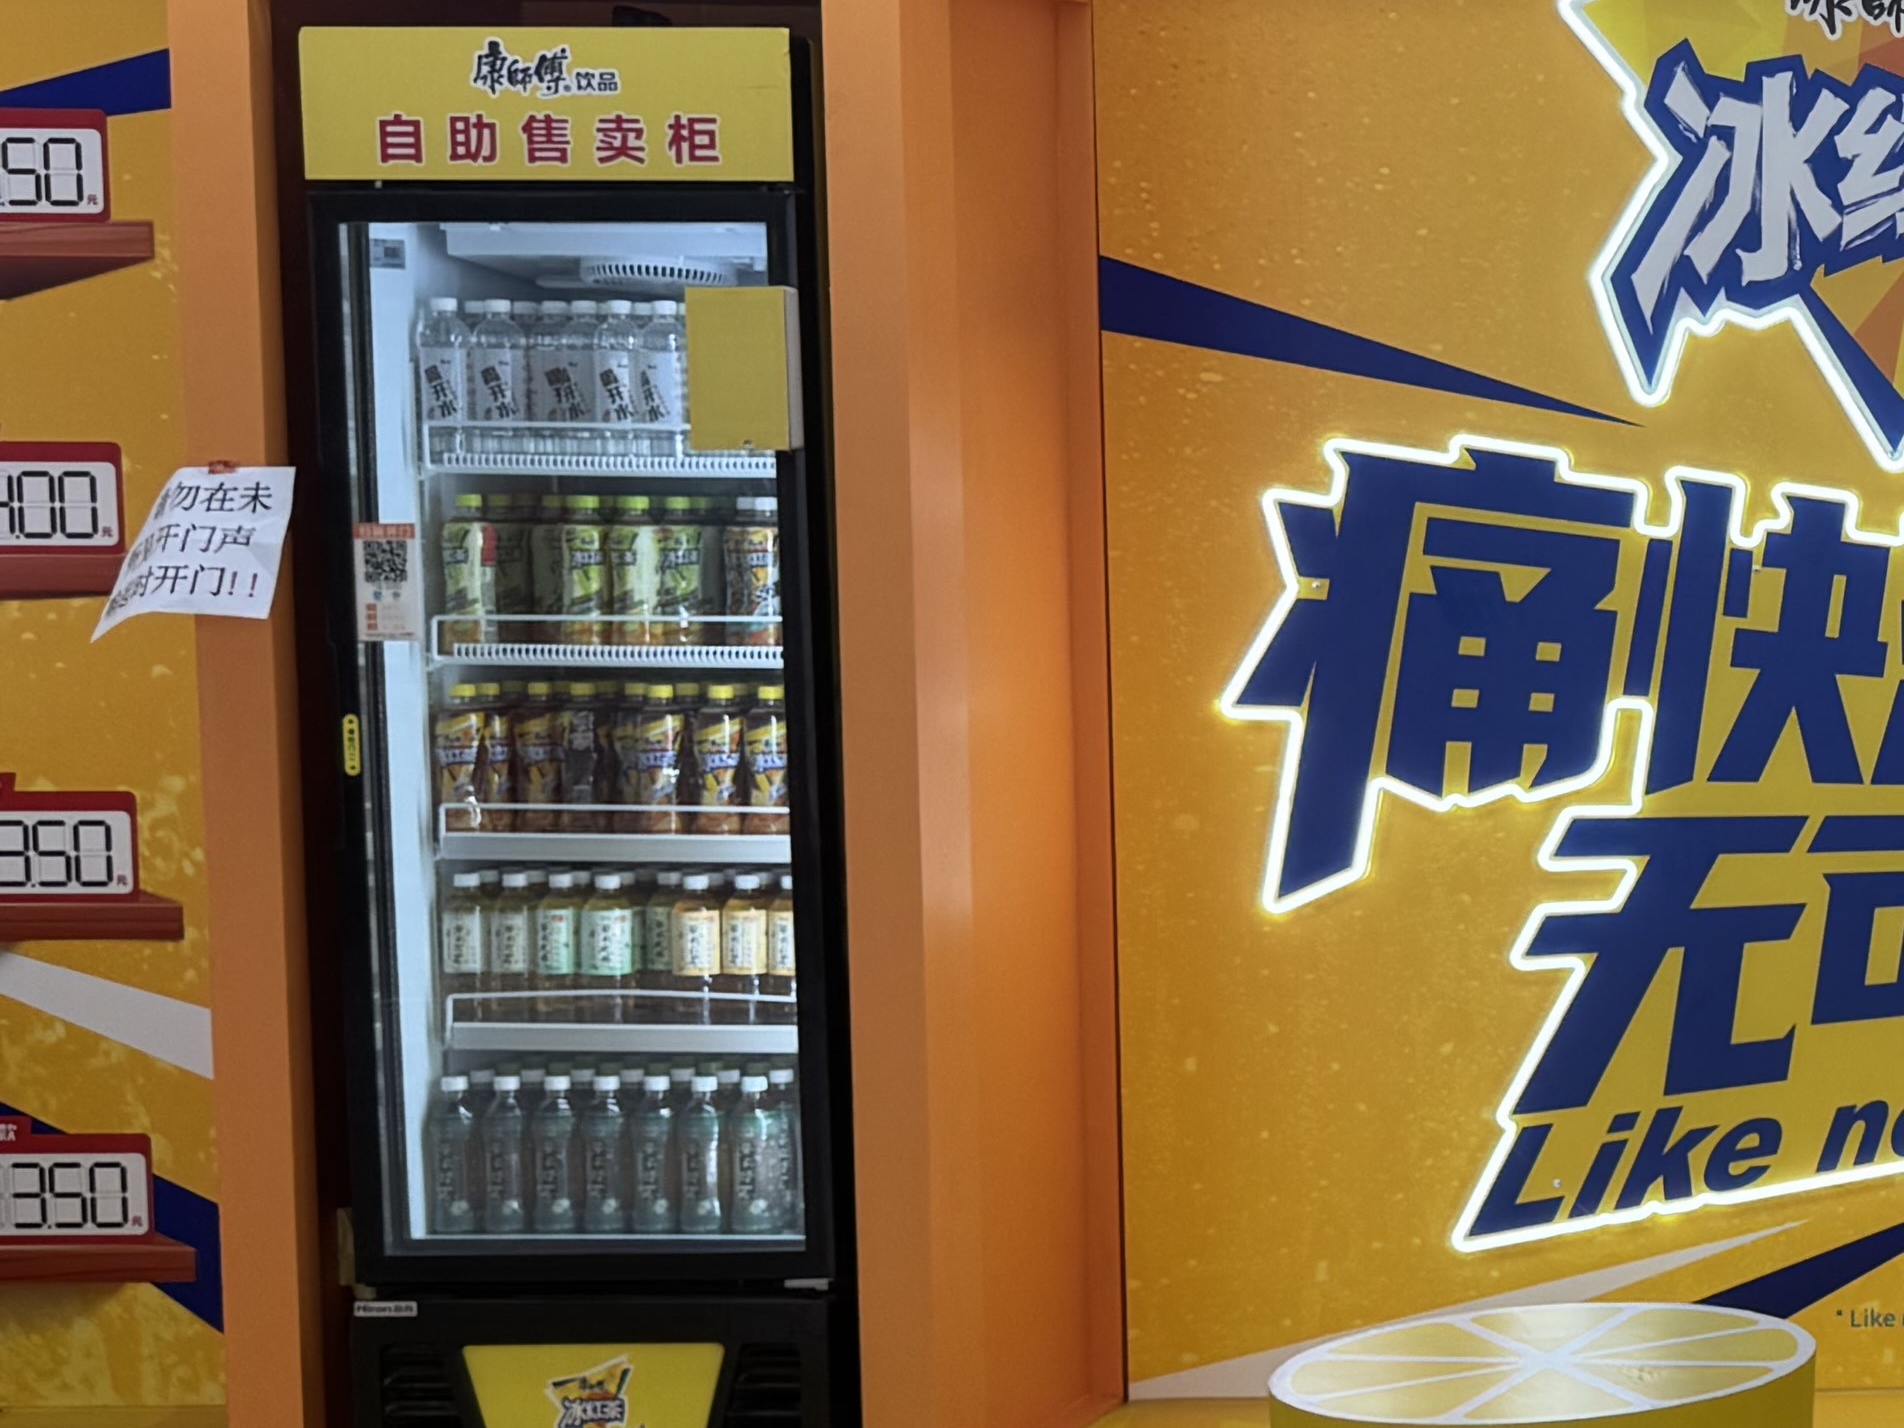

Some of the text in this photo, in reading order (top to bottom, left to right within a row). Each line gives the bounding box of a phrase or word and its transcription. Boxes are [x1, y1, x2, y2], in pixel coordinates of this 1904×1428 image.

[379, 113, 721, 165] 自助售卖柜
[1466, 1111, 1782, 1239] Like
[1850, 1309, 1896, 1328] Like
